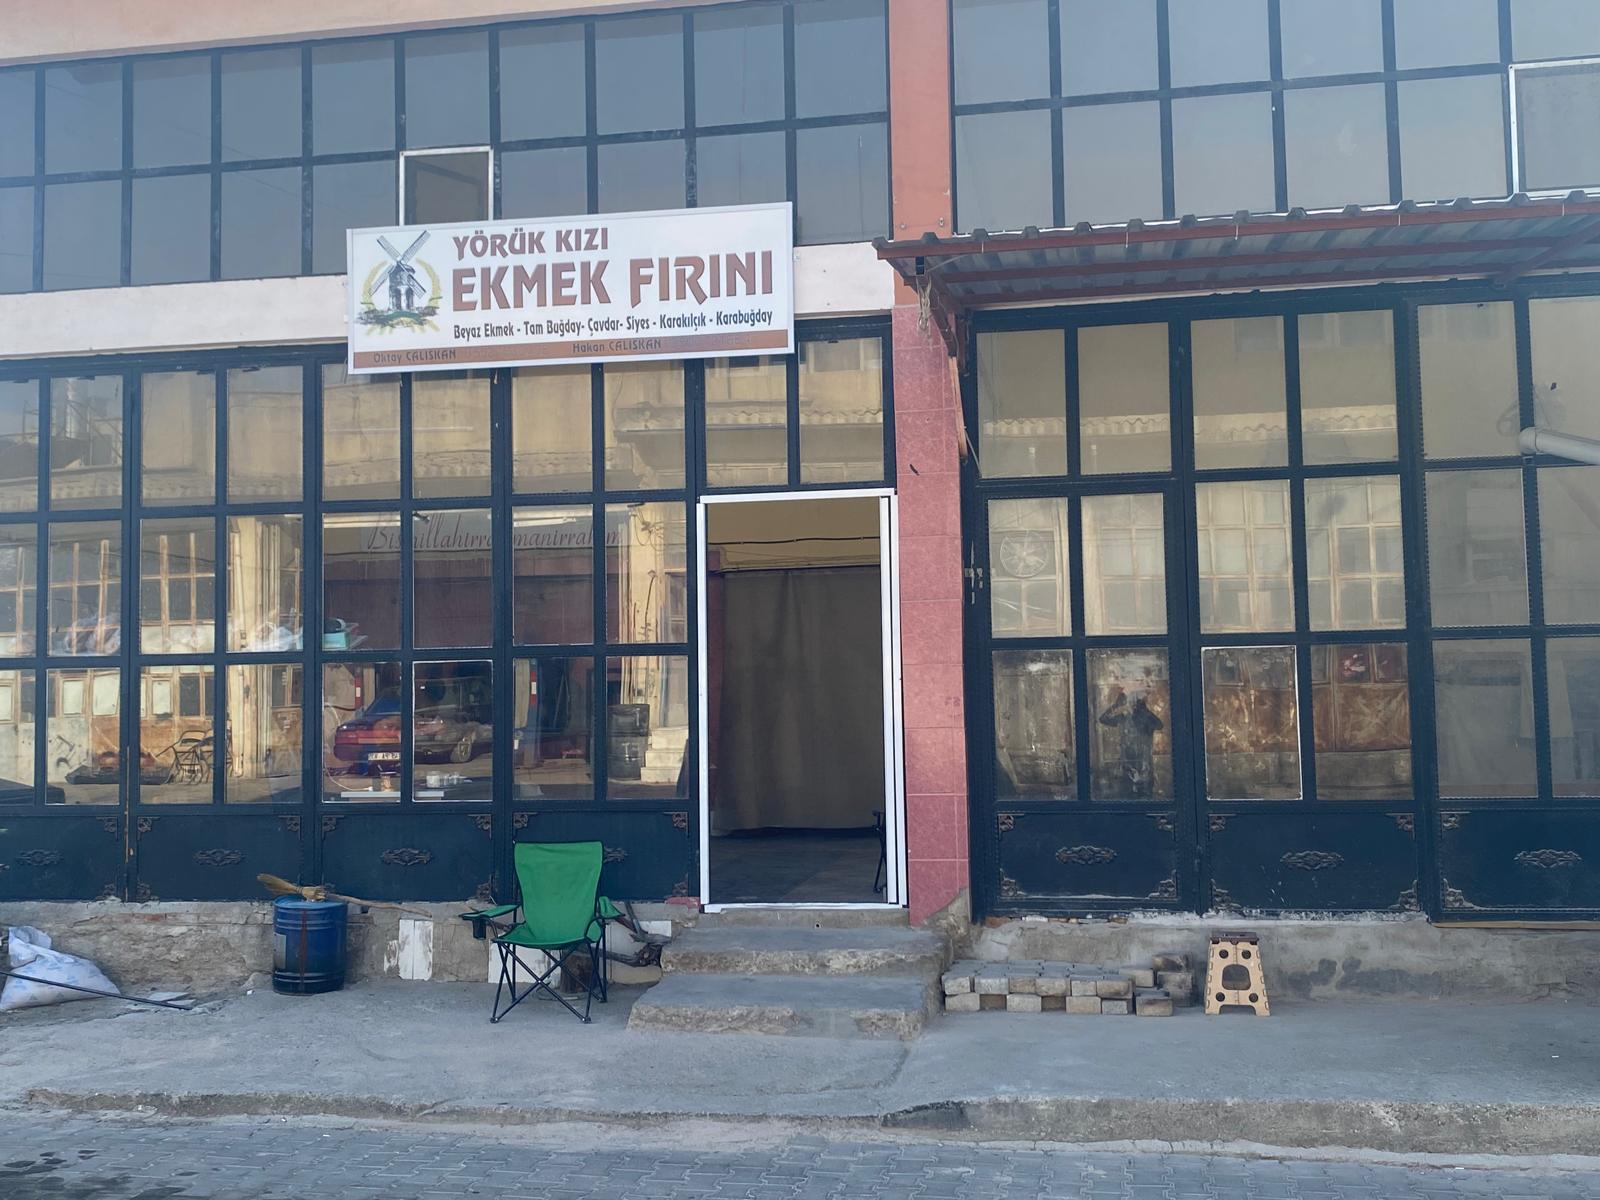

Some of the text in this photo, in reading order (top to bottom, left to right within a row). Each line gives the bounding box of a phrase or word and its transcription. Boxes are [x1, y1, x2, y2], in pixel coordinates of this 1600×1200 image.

[452, 227, 608, 261] YÖRÜK KIZI
[452, 250, 773, 312] EKMEK FIRINI
[453, 324, 481, 341] Beyaz
[484, 322, 514, 338] Ekmek
[523, 321, 544, 336] Tam
[626, 315, 650, 333] Siyes
[660, 312, 706, 331] Karakılçık
[716, 308, 773, 326] Karabuğday
[572, 342, 605, 353] Hakan
